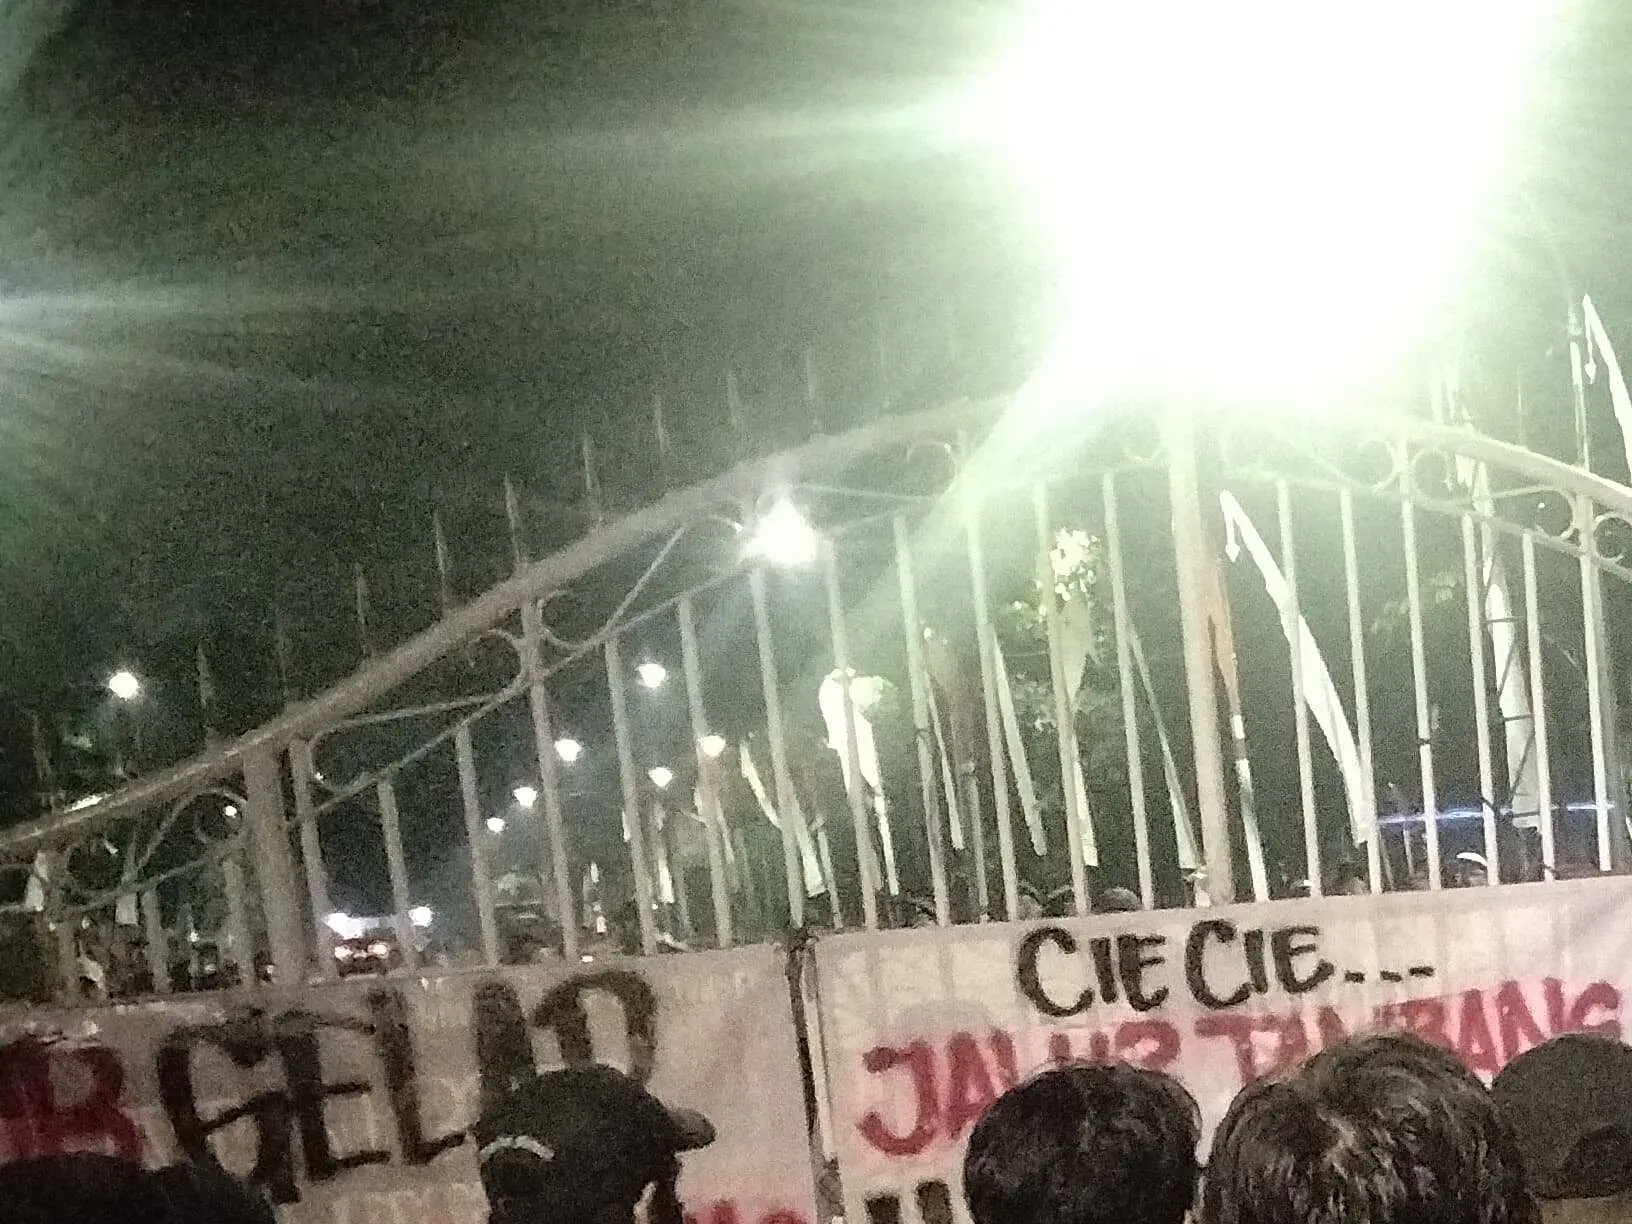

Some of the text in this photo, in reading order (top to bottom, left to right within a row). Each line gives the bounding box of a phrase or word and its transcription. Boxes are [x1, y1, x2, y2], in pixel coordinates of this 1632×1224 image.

[1016, 926, 1168, 1018] CIE
[858, 976, 1622, 1157] JAR TAANG
